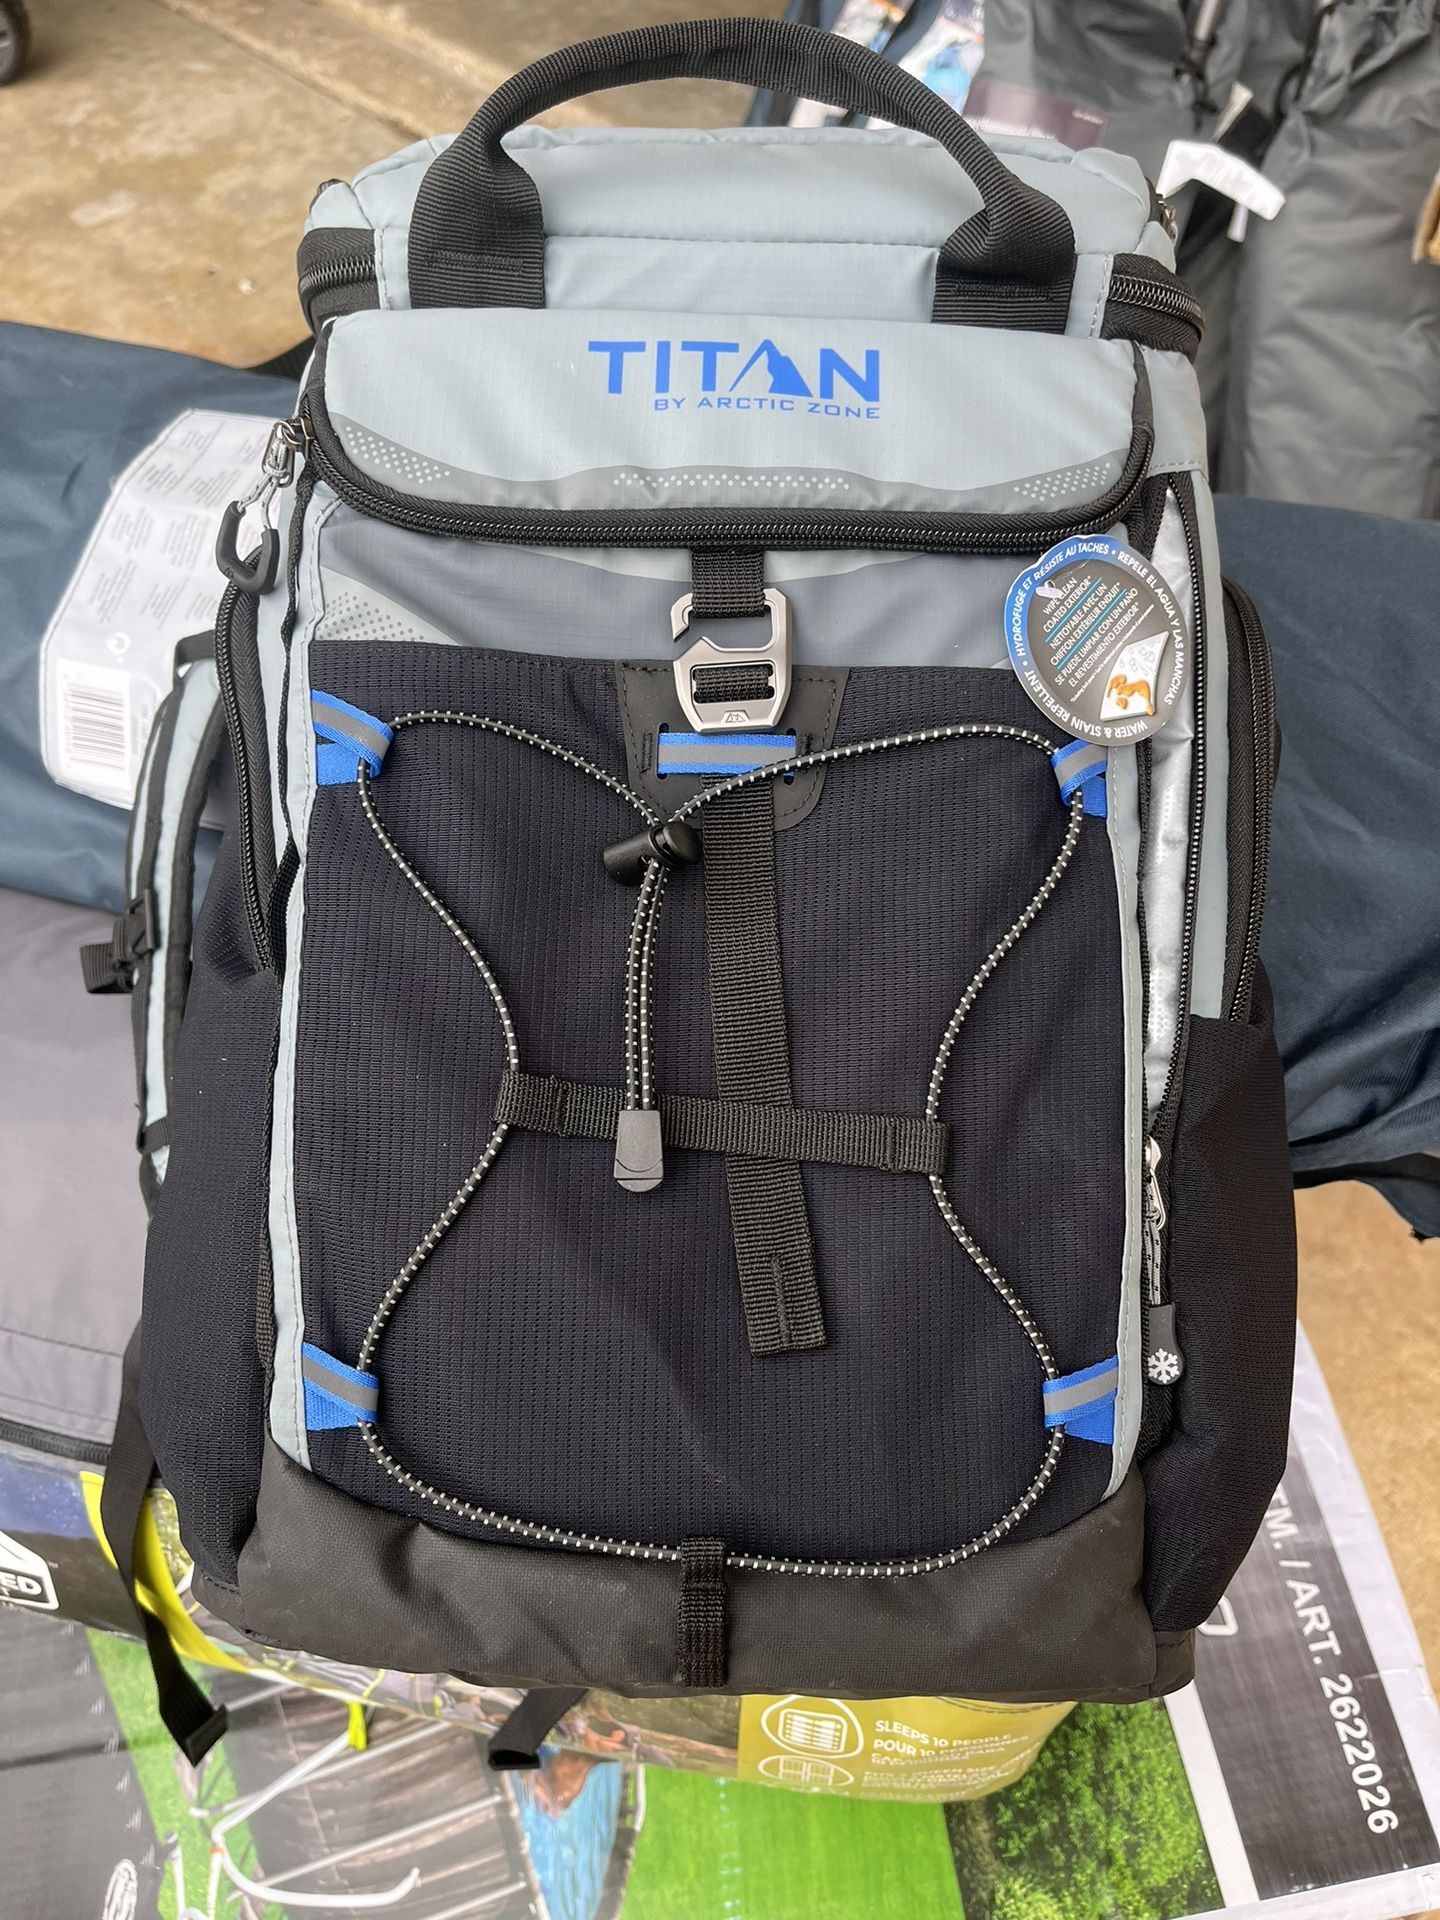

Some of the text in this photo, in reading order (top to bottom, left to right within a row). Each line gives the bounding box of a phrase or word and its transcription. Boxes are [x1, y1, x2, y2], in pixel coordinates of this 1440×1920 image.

[588, 339, 880, 402] TITAN
[654, 397, 880, 419] BY ARCTIC ZONE
[1012, 542, 1110, 657] HYDROFUGE ET RÉSISTE AU TACHES
[1042, 598, 1060, 616] WIPE
[1043, 605, 1067, 633] COATED
[1049, 583, 1108, 650] NETTOYABLE AVEC UN
[1117, 551, 1185, 705] REPELE EL AGUA Y LAS MANCHAS
[1050, 635, 1075, 666] CHIFFON
[1074, 607, 1102, 638] EXTÉRIEUR
[1054, 673, 1065, 686] SE
[1061, 656, 1082, 677] PUEDE
[1078, 631, 1101, 658] LIMPIAR
[1097, 616, 1113, 634] CON
[1110, 605, 1123, 619] UN
[1068, 677, 1079, 688] EL
[1074, 632, 1116, 680] REVESTIMIENTO
[1024, 670, 1148, 739] WATER & STAIN REPELLENT
[875, 1720, 1011, 1748] SLEEPS 10 PEOPLE
[1286, 1579, 1342, 1666] ART.
[1320, 1673, 1399, 1835] 2622026
[873, 1739, 917, 1757] POUR
